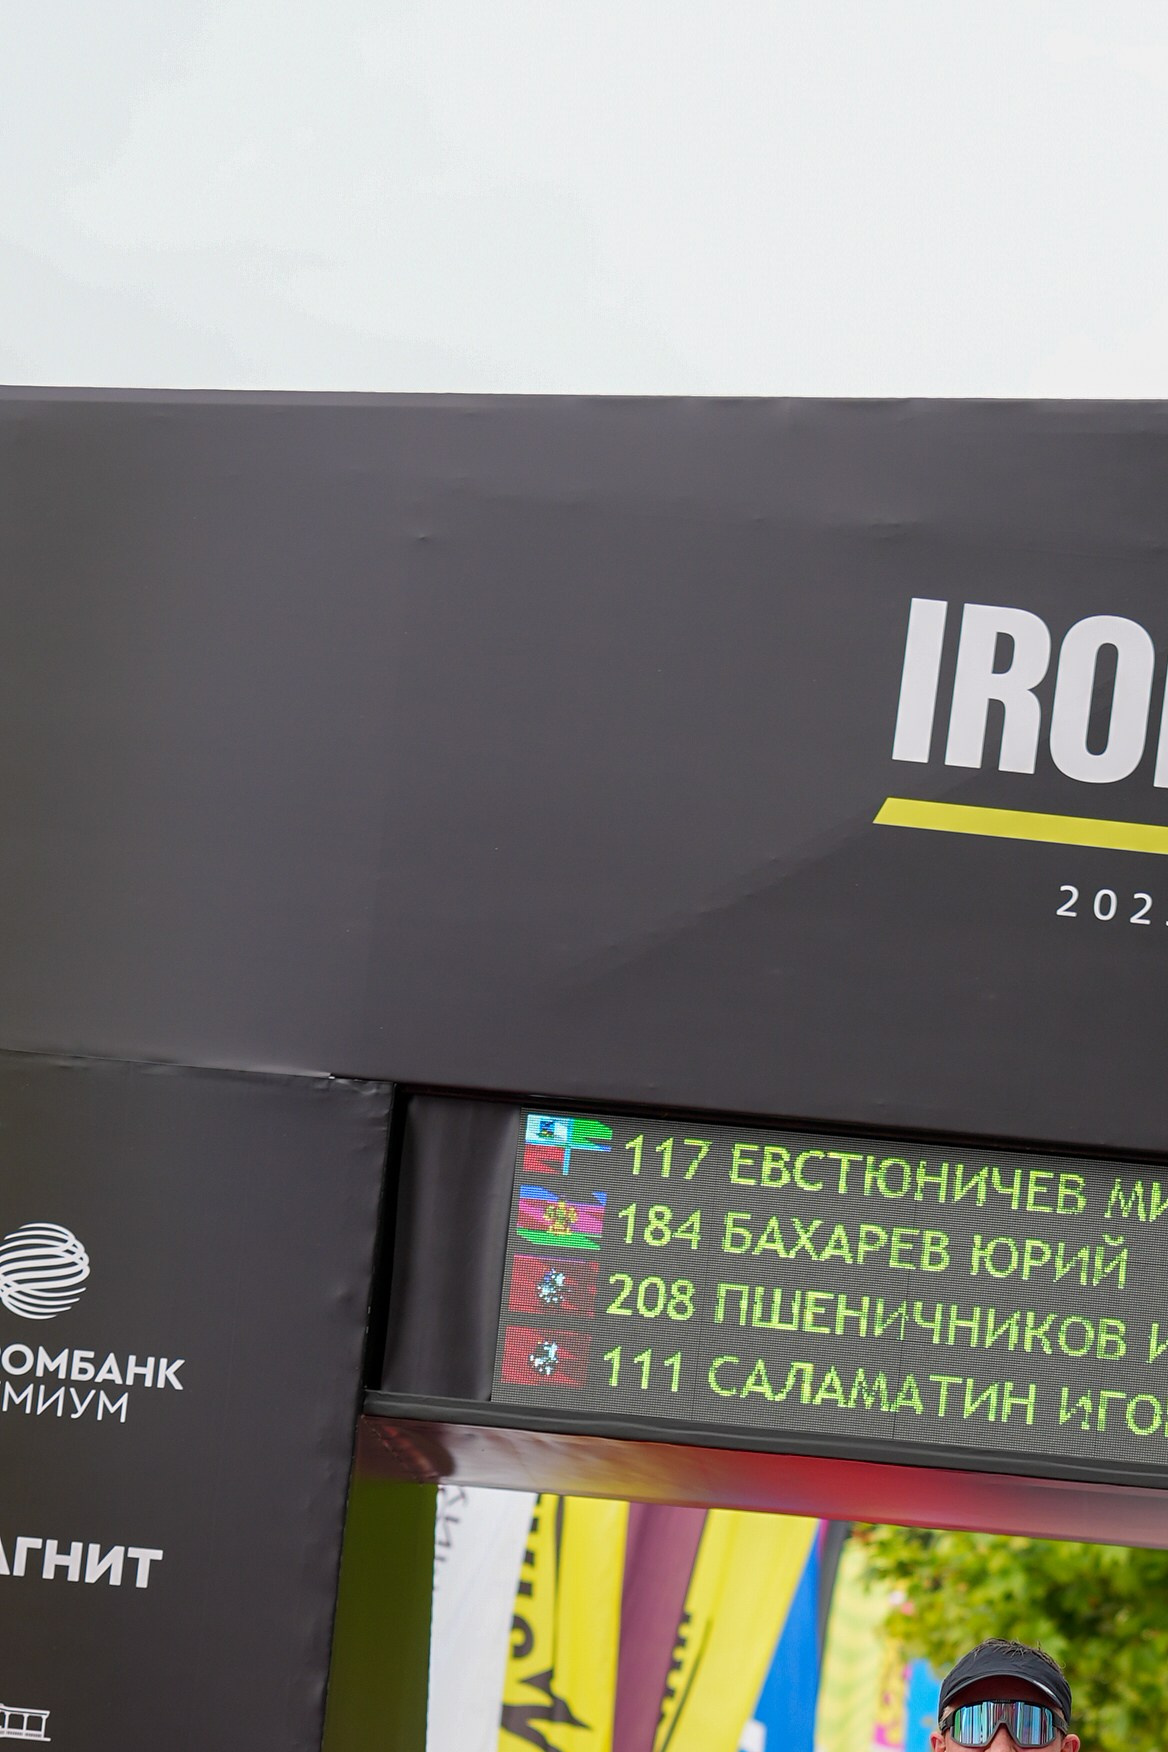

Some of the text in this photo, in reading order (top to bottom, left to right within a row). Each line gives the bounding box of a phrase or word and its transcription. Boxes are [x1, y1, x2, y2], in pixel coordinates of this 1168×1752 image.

[623, 1135, 711, 1180] 117
[729, 1142, 1087, 1214] ЕВСТЮНИЧЕВ
[618, 1203, 1128, 1289] 184 БАХАРЕВ ЮРИЙ
[607, 1272, 696, 1321] 208
[714, 1282, 1127, 1360] ПШЕНИЧНИКОВ
[0, 1343, 185, 1391] ОМБАНК
[0, 1380, 129, 1423] МИУМ
[604, 1345, 682, 1391] 111
[707, 1355, 1036, 1425] САЛАМАТИН
